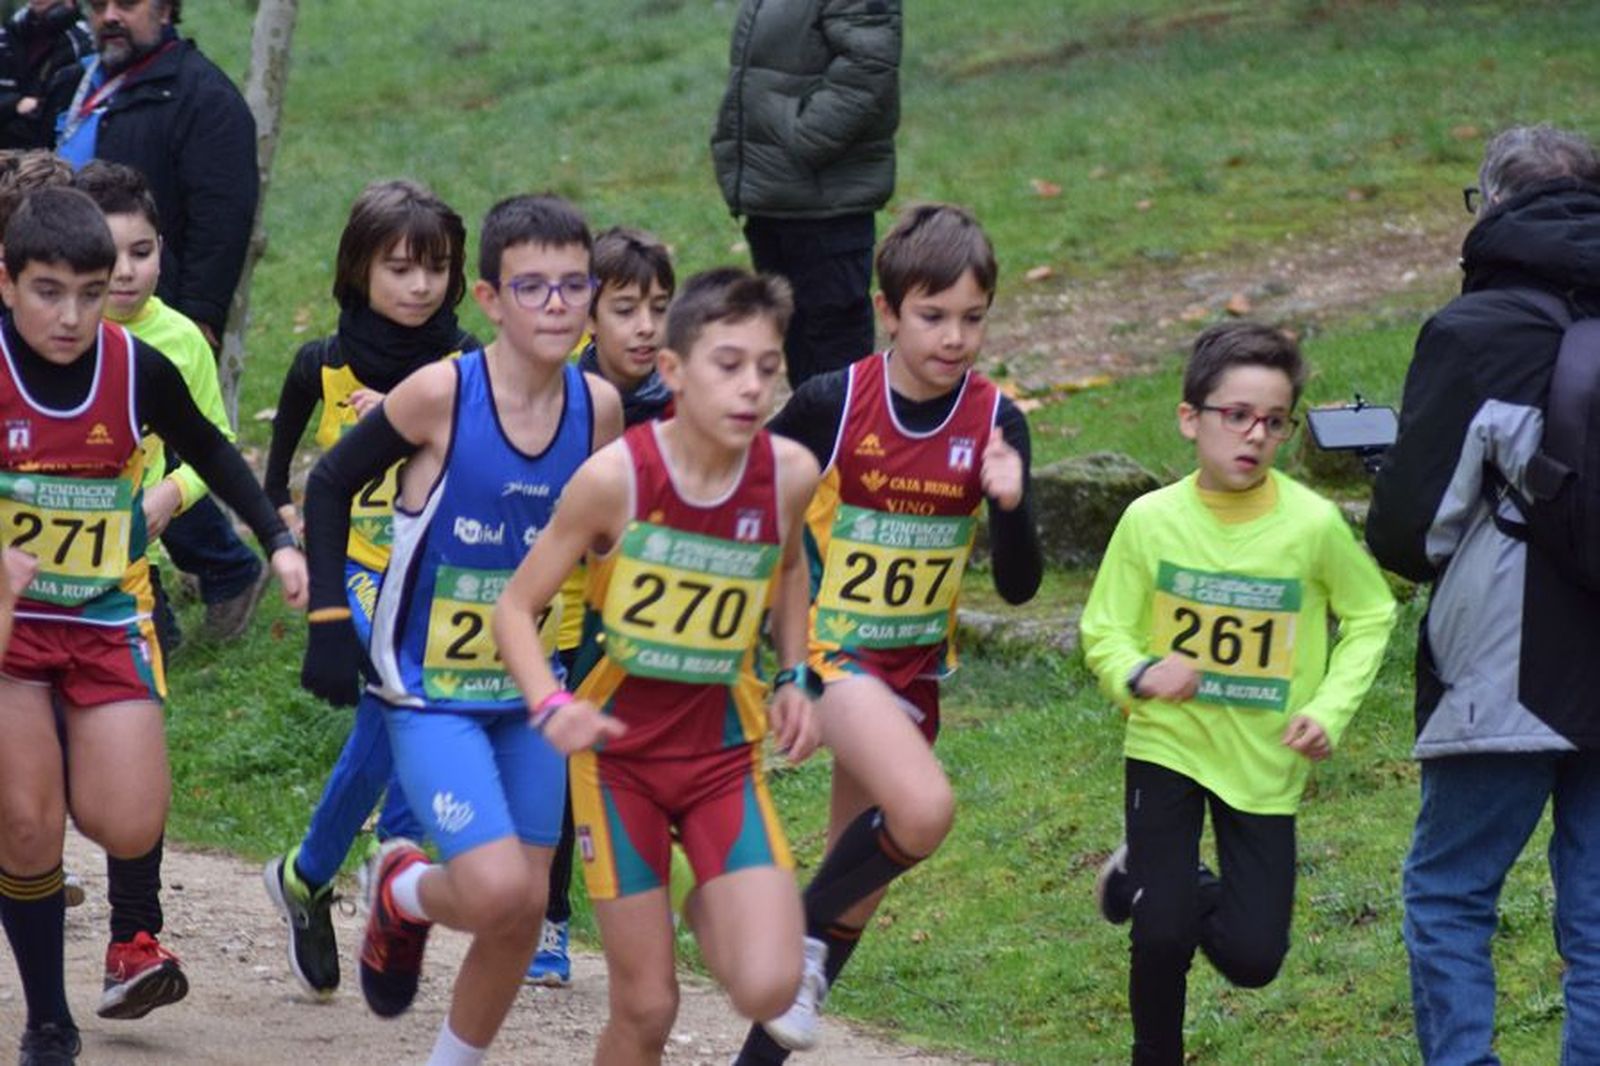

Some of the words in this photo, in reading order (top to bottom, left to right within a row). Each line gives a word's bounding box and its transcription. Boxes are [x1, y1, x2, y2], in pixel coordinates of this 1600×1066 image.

[889, 476, 920, 491] CAJA
[923, 480, 965, 498] RURAL
[9, 512, 107, 568] 271
[622, 573, 748, 641] 270
[839, 552, 954, 608] 267
[637, 649, 680, 670] CAJA
[857, 623, 895, 640] CAJA
[1171, 606, 1274, 669] 261
